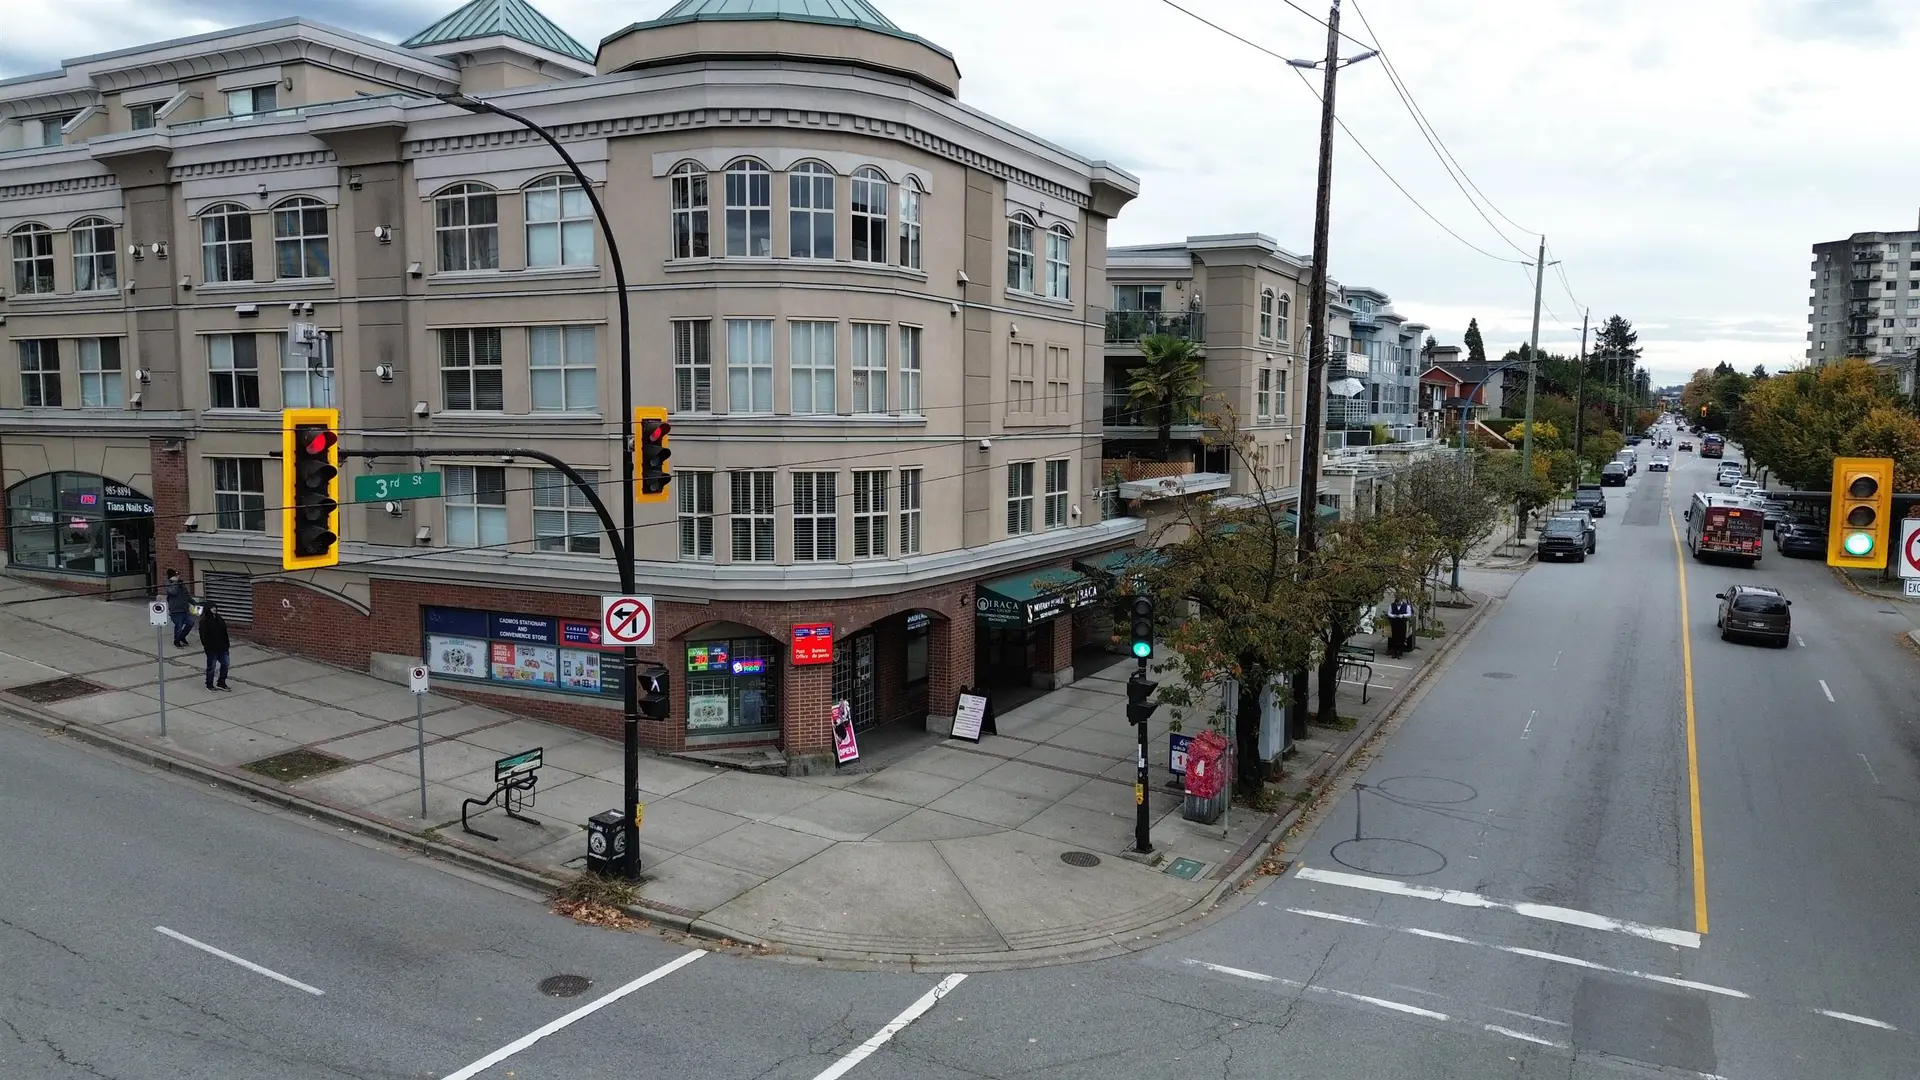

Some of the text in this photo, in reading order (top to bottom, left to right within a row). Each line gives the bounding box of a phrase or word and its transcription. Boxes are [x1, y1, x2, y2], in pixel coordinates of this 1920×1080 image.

[105, 485, 131, 496] 985-8894
[376, 475, 422, 499] 3rd St
[106, 501, 124, 511] Tiana
[125, 502, 142, 512] Nails
[989, 600, 1019, 610] IRACA
[519, 619, 547, 627] STATIONARY
[500, 631, 547, 641] CONVENIENCE STORE
[839, 746, 856, 756] OPEN
